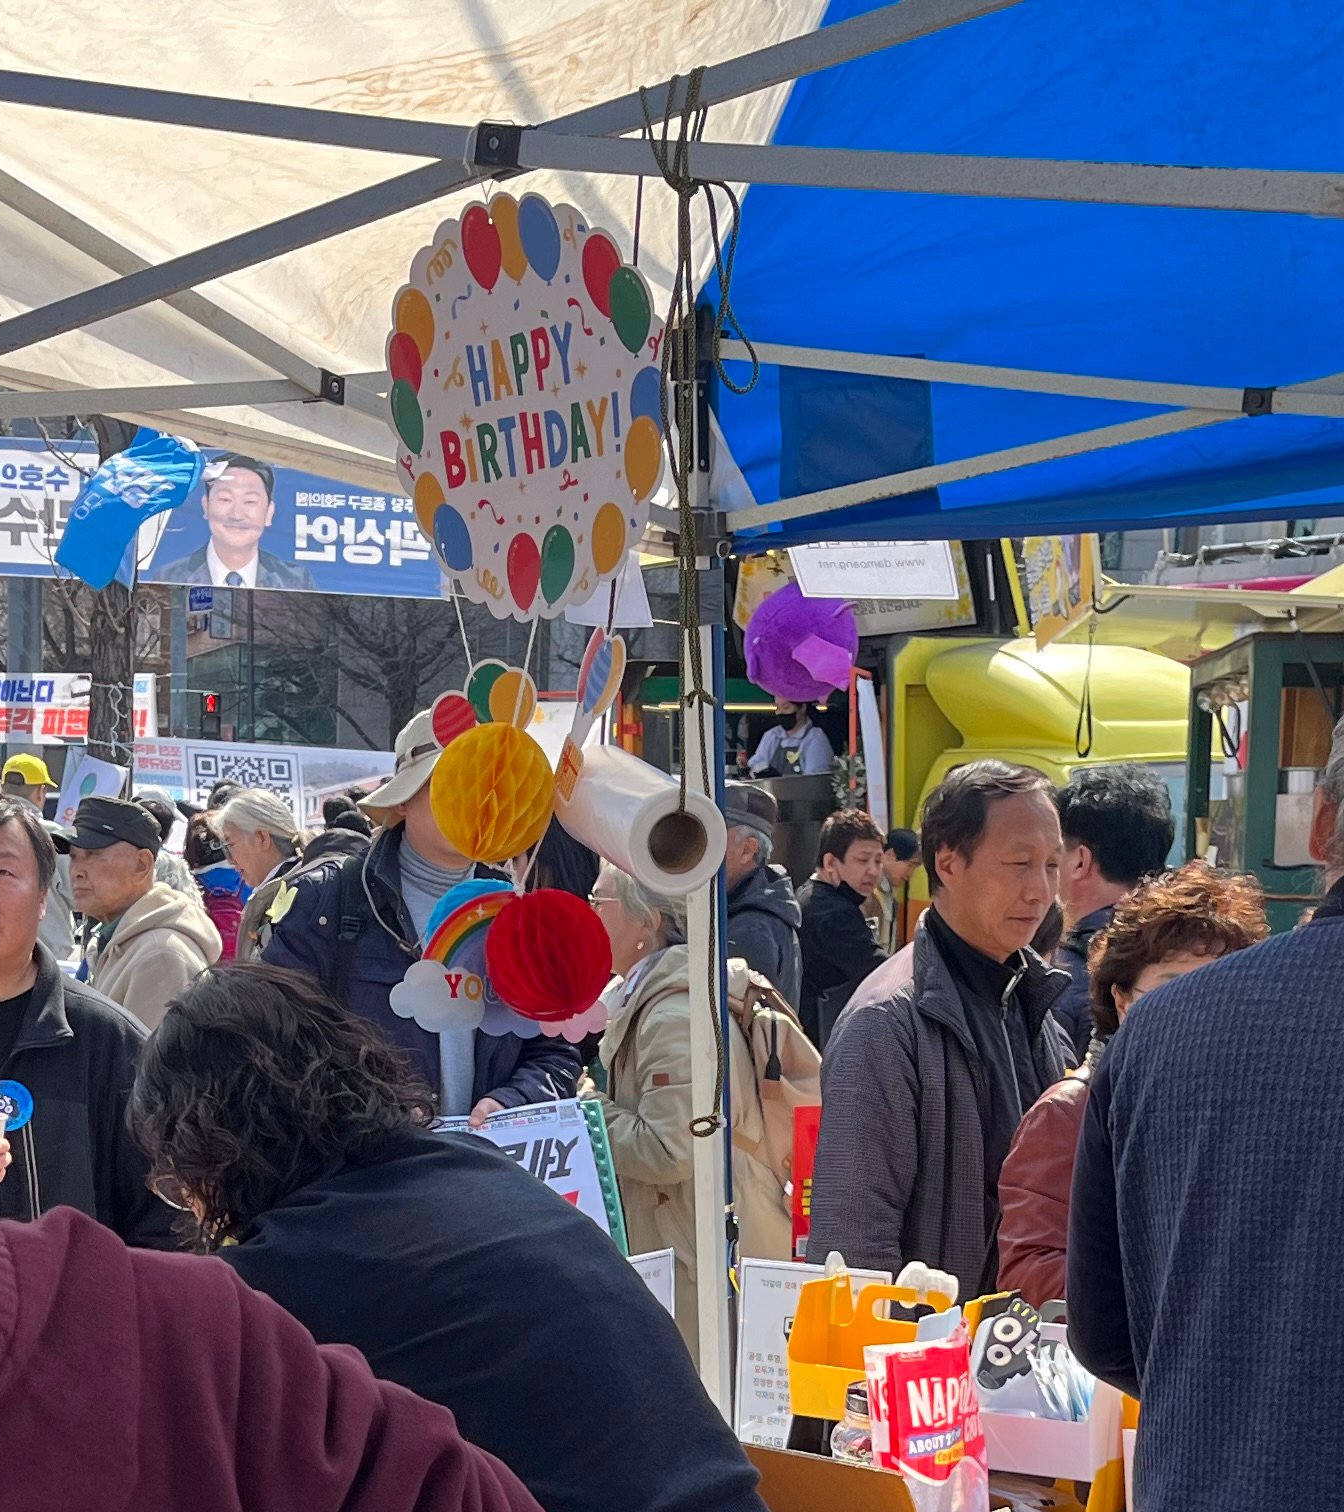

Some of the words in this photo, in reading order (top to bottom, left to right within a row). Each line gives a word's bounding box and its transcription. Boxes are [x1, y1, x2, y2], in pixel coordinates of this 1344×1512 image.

[465, 321, 573, 407] HAPPY
[440, 391, 621, 489] BIRTHDAY!
[908, 1433, 945, 1456] ABOUT
